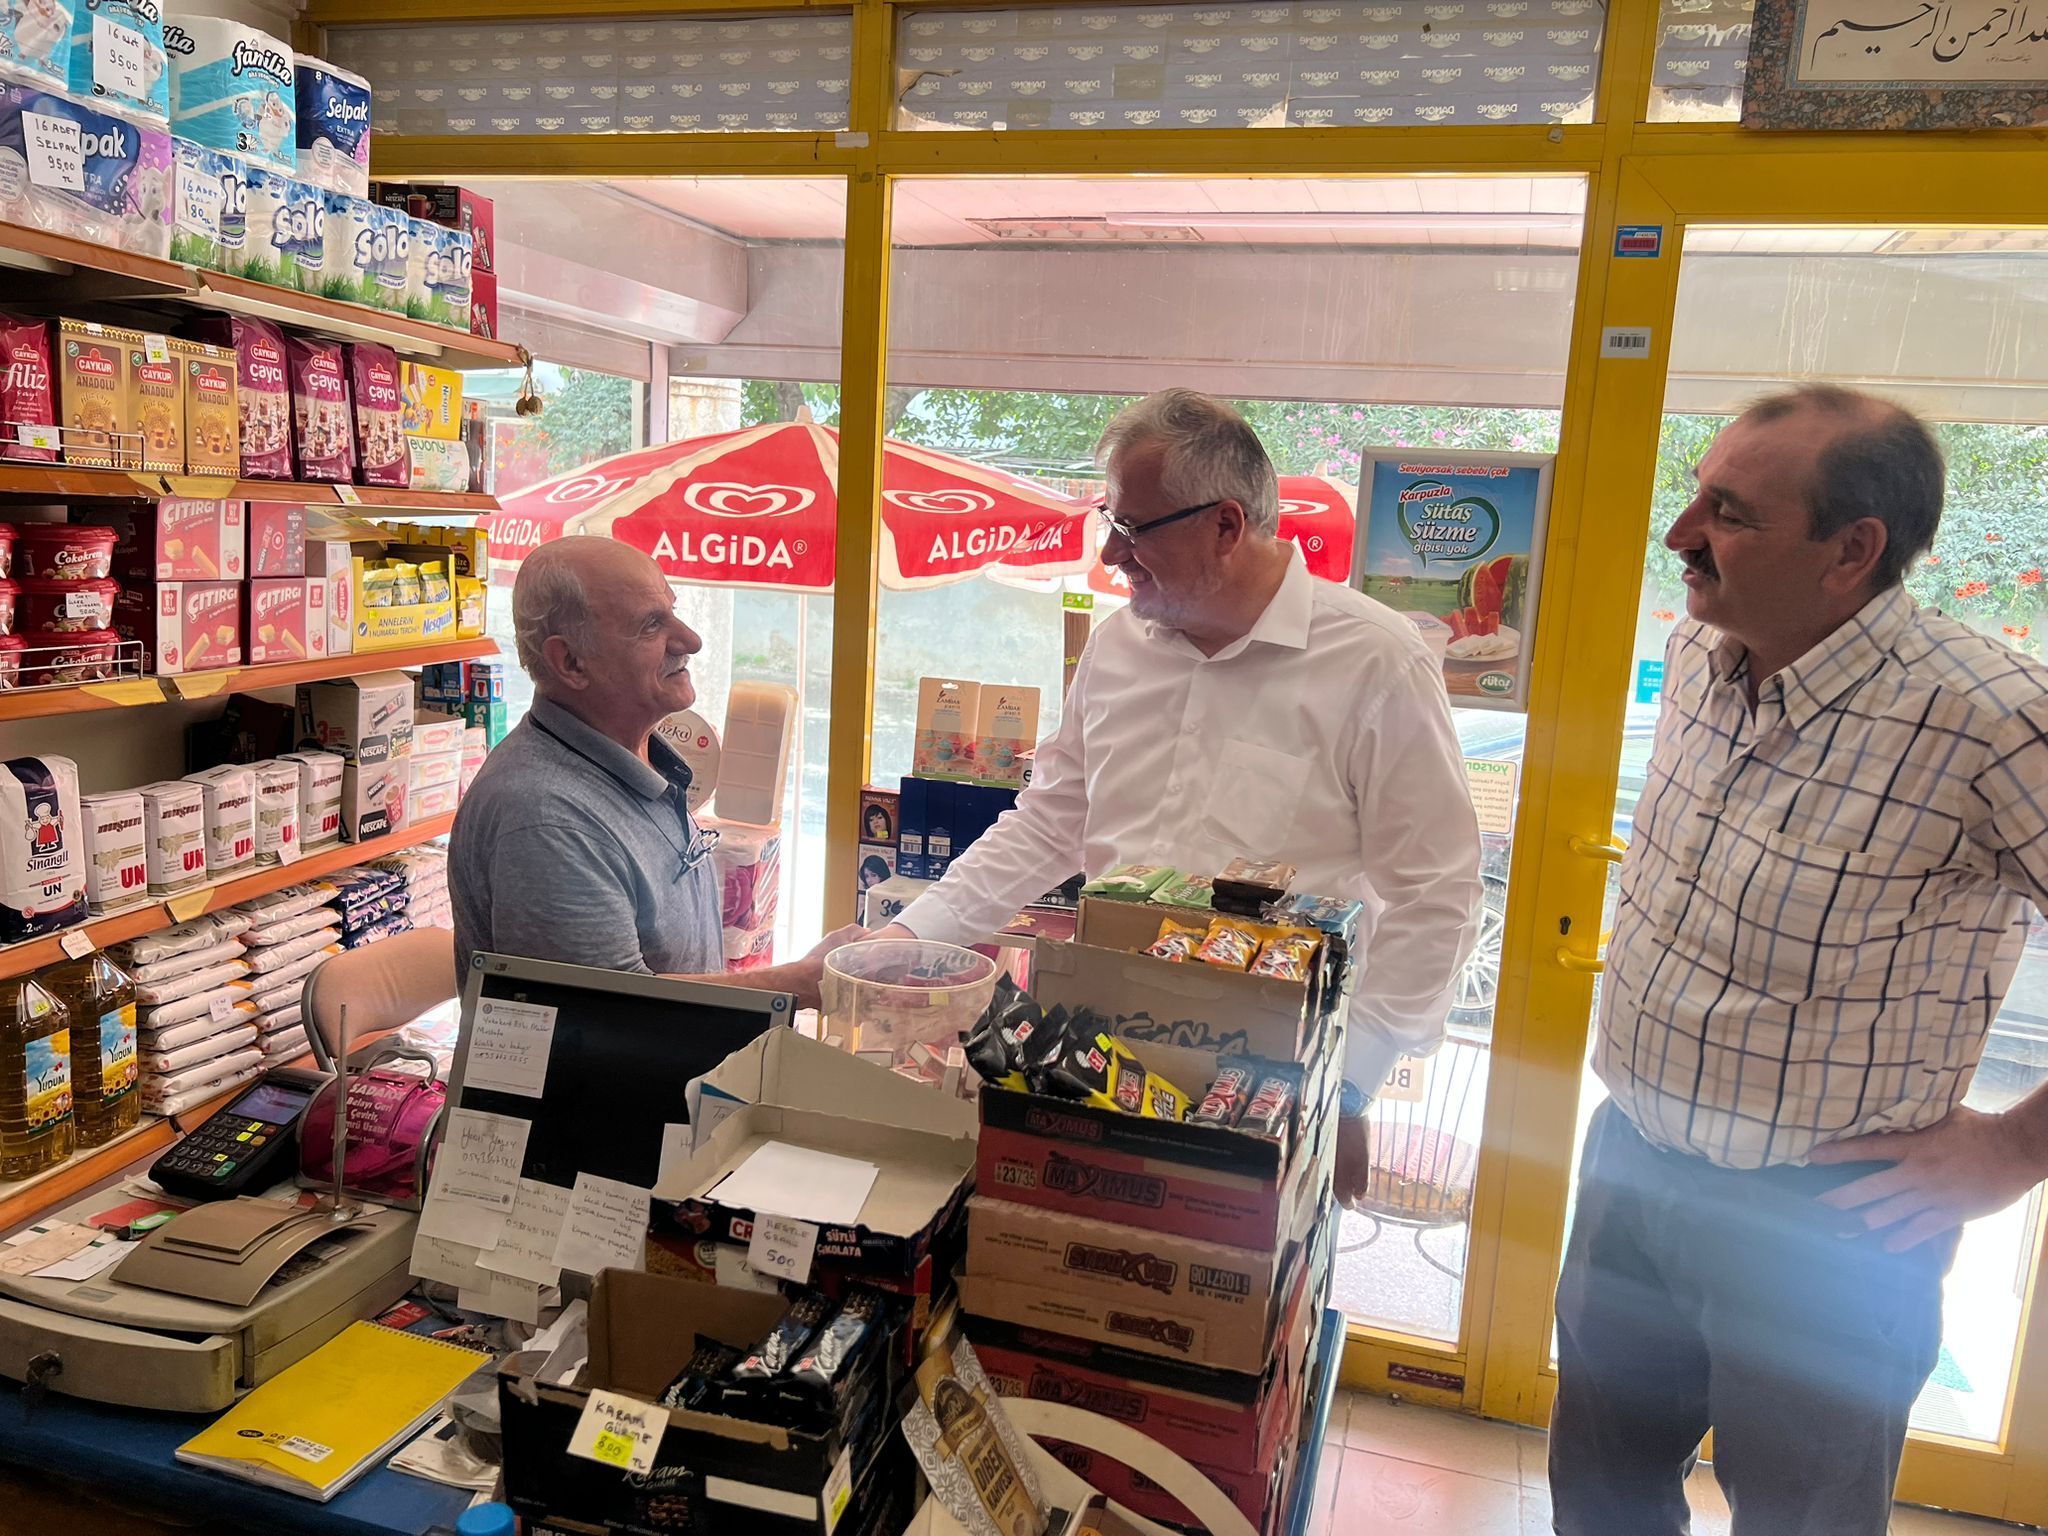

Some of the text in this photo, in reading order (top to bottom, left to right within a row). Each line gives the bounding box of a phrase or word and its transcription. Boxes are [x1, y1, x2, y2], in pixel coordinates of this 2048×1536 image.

[163, 26, 195, 55] ilia
[326, 96, 369, 125] Selpak
[52, 124, 77, 137] ADET
[36, 136, 80, 155] SELPAK
[80, 126, 128, 167] pak
[221, 174, 246, 216] lo
[2, 362, 47, 392] filiz
[76, 375, 115, 391] ANADOLU
[139, 384, 175, 398] ANADOLU
[197, 393, 230, 406] ANADOLU
[1399, 463, 1509, 478] Seviyorsak sebebi çok
[1400, 486, 1451, 503] Karpuzla
[1421, 503, 1473, 523] Sütaş
[1410, 521, 1478, 542] Süzme
[1413, 543, 1469, 555] gibisi yok
[422, 609, 454, 635] Nesquik
[1480, 675, 1512, 691] sütaş
[322, 813, 339, 832] UN
[26, 850, 69, 873] Sinangil
[183, 848, 204, 871] UN
[120, 864, 146, 889] UN
[44, 882, 62, 897] UN
[27, 923, 34, 934] 2
[346, 1096, 374, 1110] Belayı
[345, 1120, 361, 1130] mrü
[1027, 1109, 1102, 1139] MAXIMUS
[1003, 1166, 1036, 1188] 23735
[1049, 1160, 1163, 1205] MAXIMUS
[825, 1229, 857, 1243] SÜTLÜ
[766, 1249, 796, 1268] 500
[594, 1398, 647, 1430] KARAM
[603, 1420, 654, 1445] GÜRME
[621, 1465, 694, 1488] Karam
